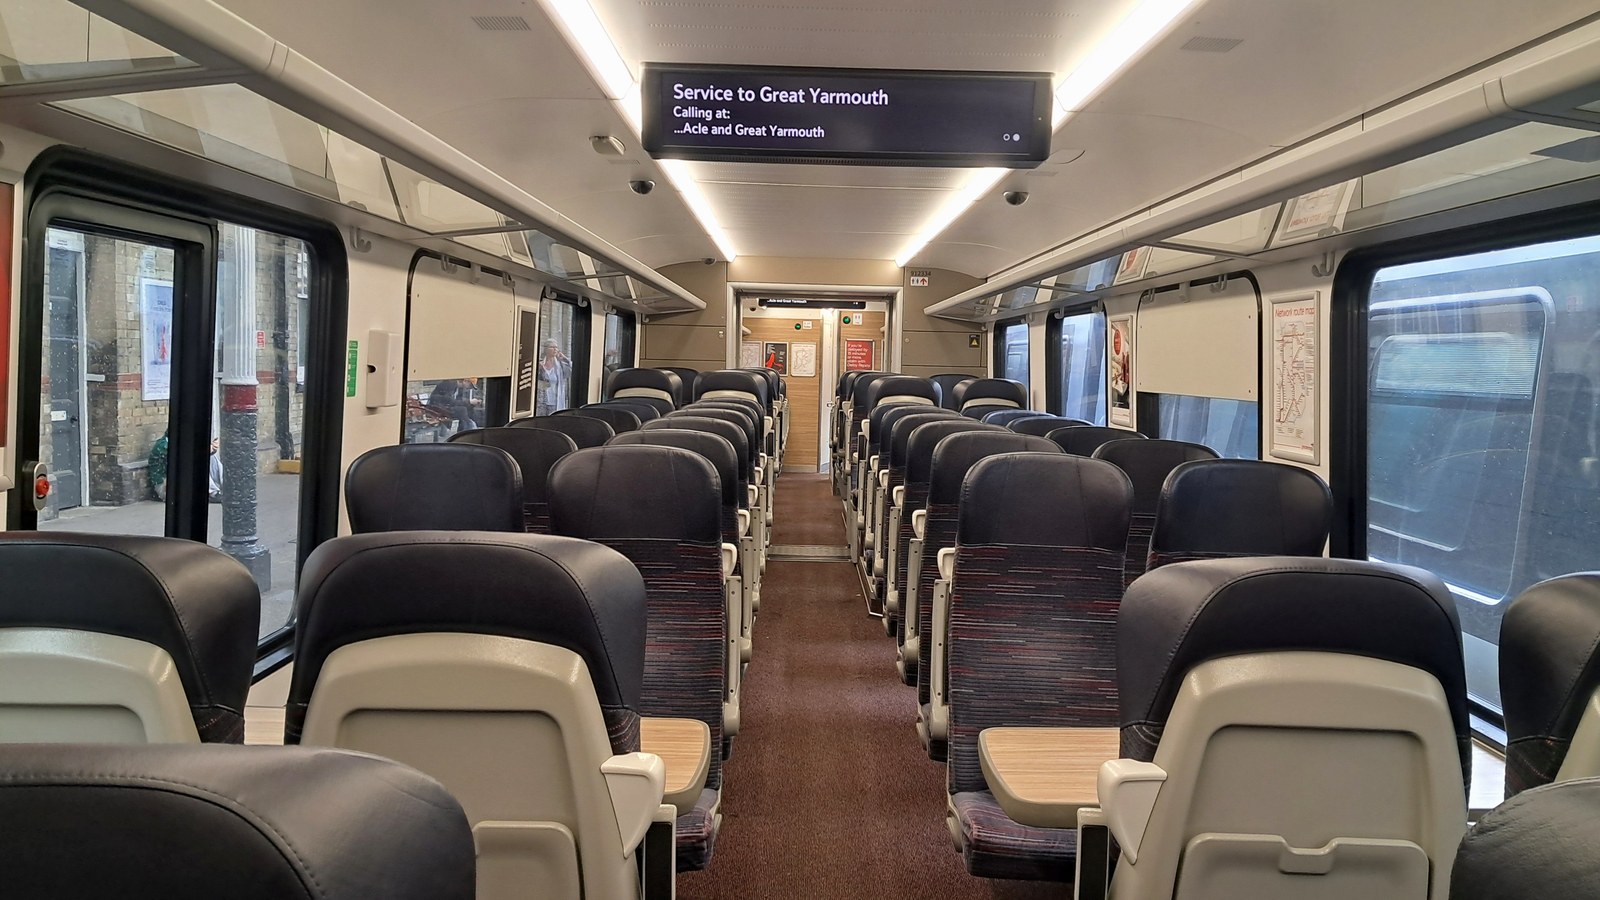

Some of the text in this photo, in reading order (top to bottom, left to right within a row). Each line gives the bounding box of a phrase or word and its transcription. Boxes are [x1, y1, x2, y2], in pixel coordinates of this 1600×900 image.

[673, 83, 888, 105] Service to Great Yarmouth
[673, 106, 731, 121] Calling at:
[673, 122, 824, 137] ...Acle and Great Yarmouth
[1275, 308, 1292, 317] Network
[1294, 308, 1304, 316] route
